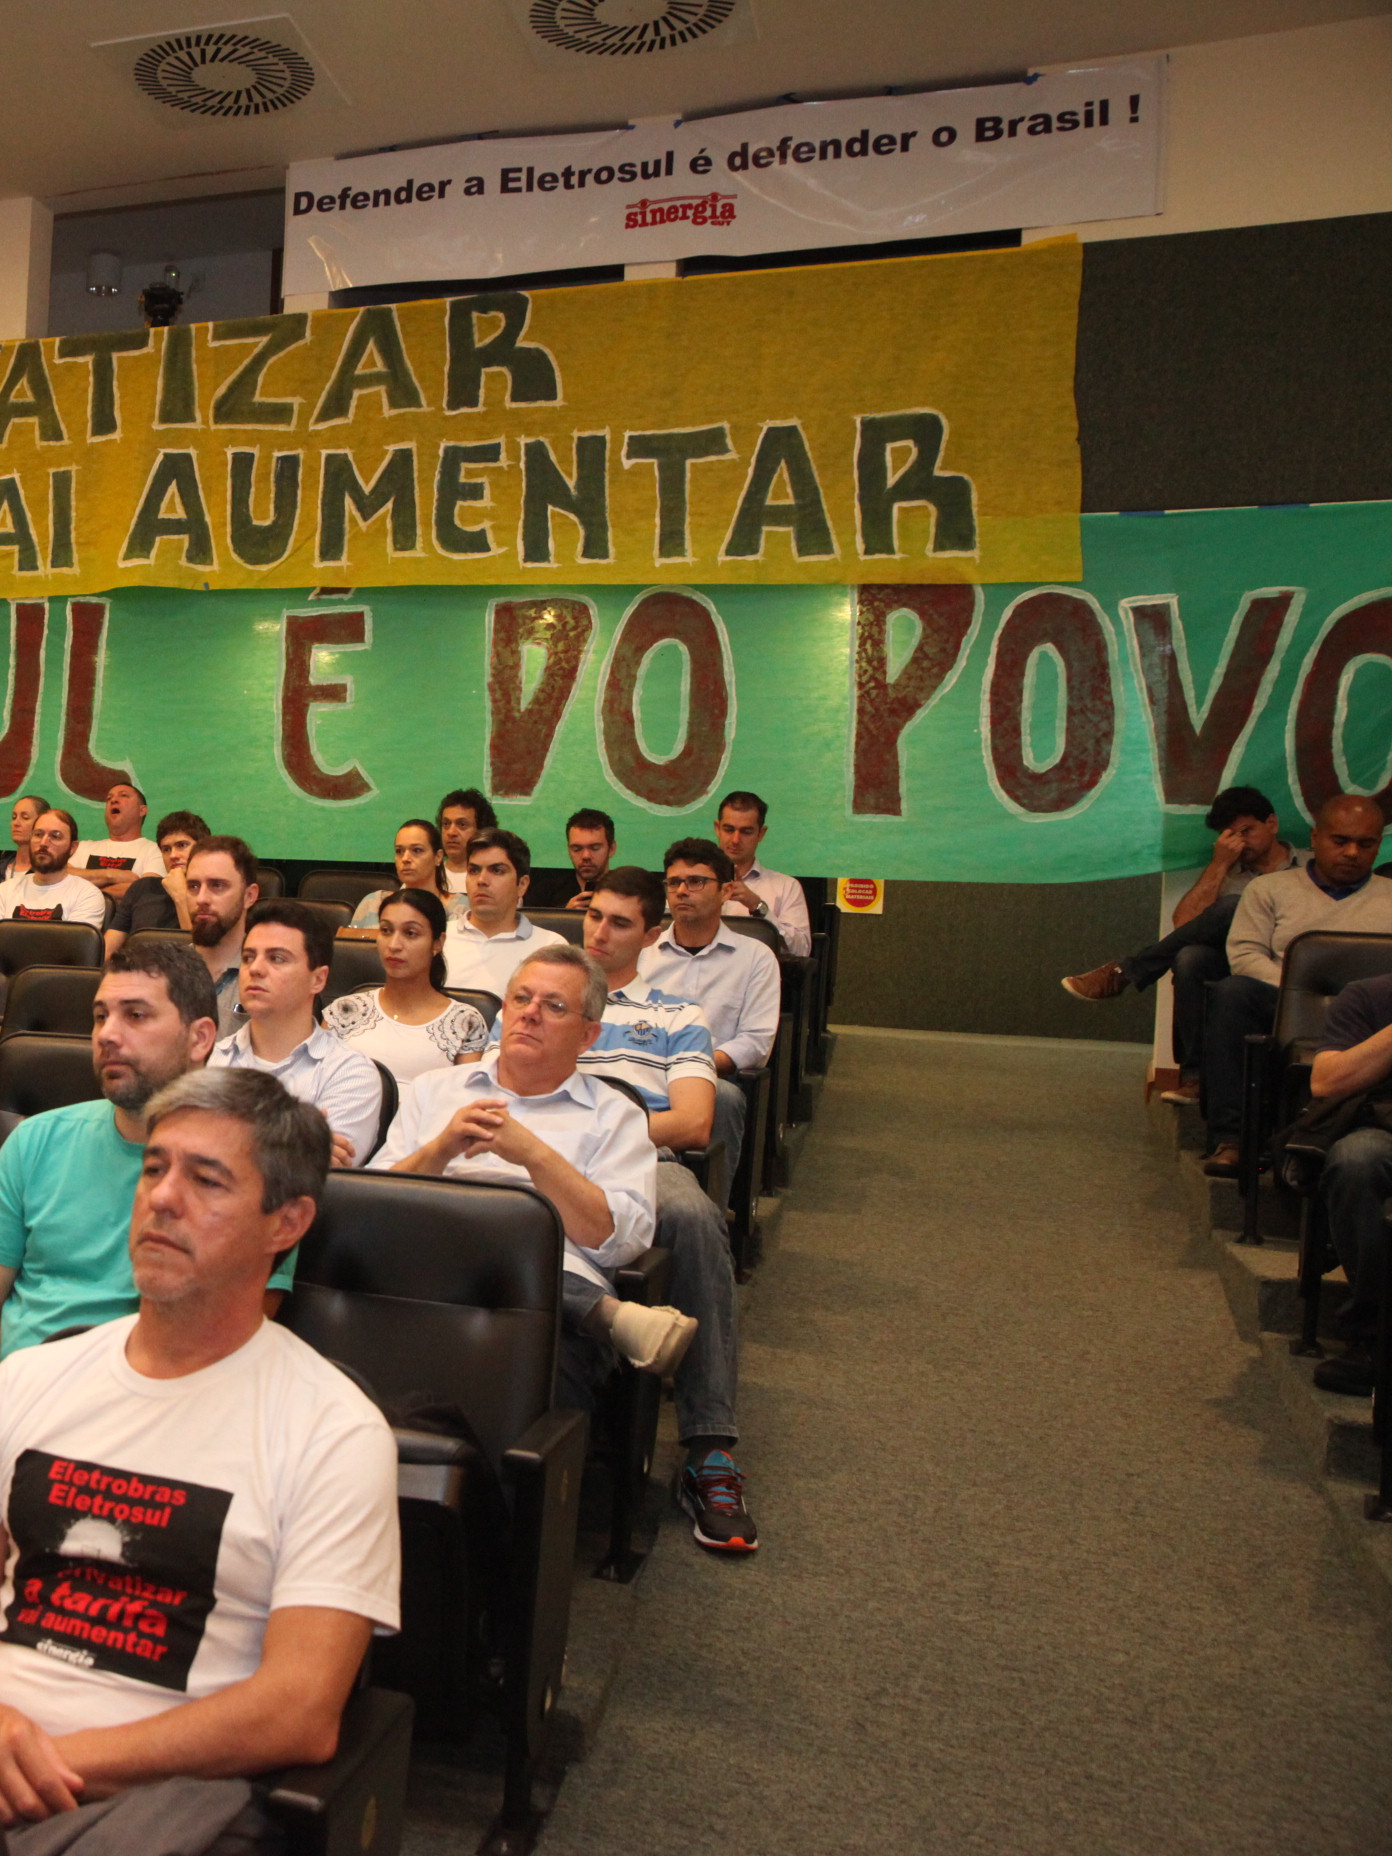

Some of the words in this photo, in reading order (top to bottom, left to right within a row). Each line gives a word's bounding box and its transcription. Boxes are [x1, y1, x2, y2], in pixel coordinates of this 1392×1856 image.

[292, 176, 452, 216] Defender
[463, 174, 485, 196] a
[499, 151, 675, 194] Eletrosul
[689, 148, 713, 175] é
[727, 129, 918, 172] defender
[931, 125, 957, 148] o
[974, 99, 1109, 143] Brasil
[1127, 94, 1141, 123] !
[625, 194, 737, 229] sinergia
[118, 409, 979, 571] AUMENTAR
[275, 583, 380, 806] É
[483, 585, 738, 815] DO
[847, 583, 1392, 824] POVO
[48, 1460, 187, 1506] Eletrobras
[48, 1484, 172, 1528] Eletrosul
[23, 1578, 43, 1604] a
[50, 1581, 168, 1638] tarifa
[40, 1611, 169, 1662] aumentar
